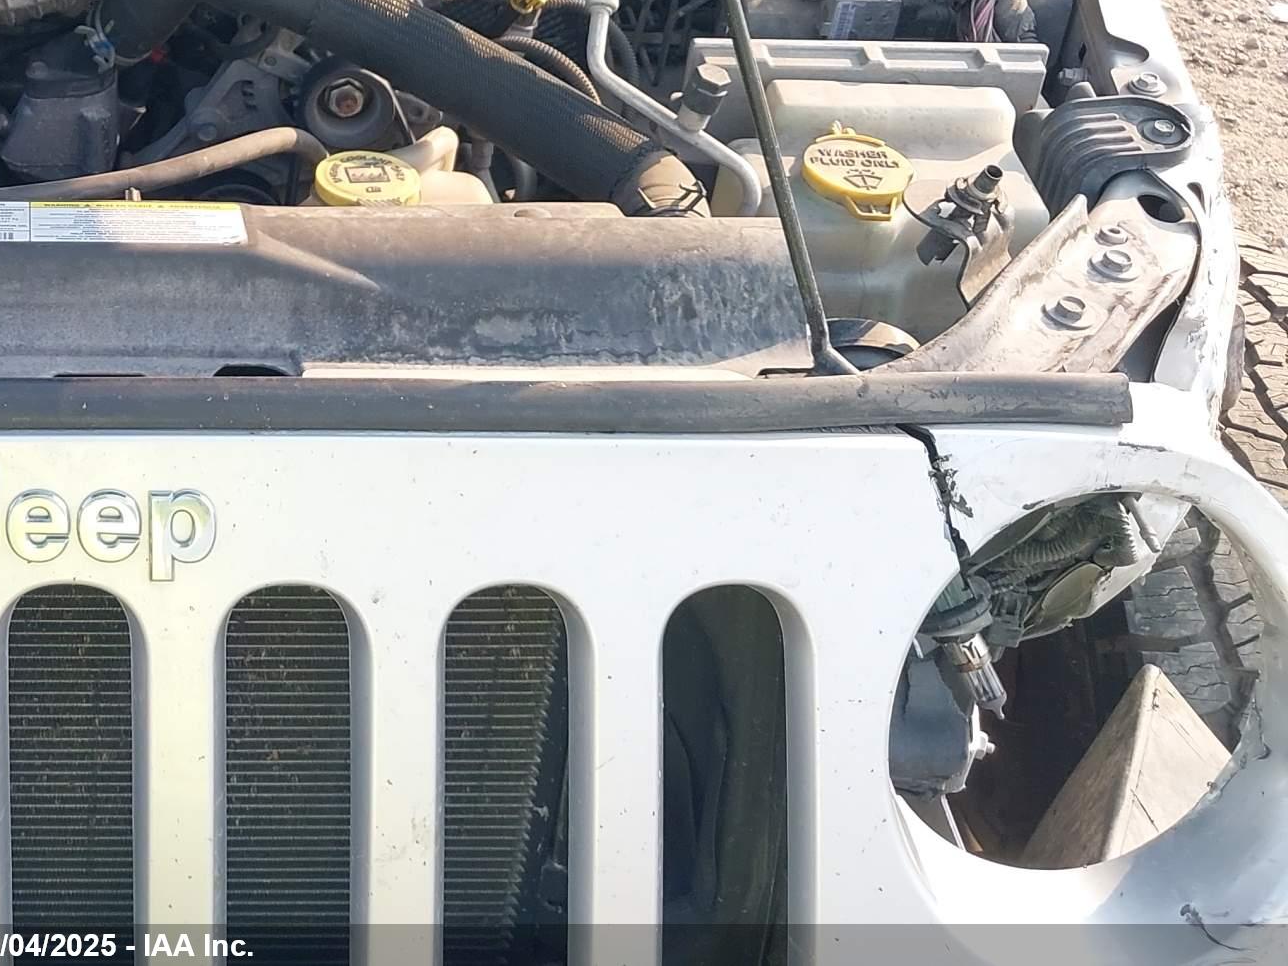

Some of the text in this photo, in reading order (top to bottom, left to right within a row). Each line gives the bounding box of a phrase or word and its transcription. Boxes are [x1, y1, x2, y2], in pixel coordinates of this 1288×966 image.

[817, 148, 888, 160] WASHER
[809, 156, 900, 169] FLUID ONLY
